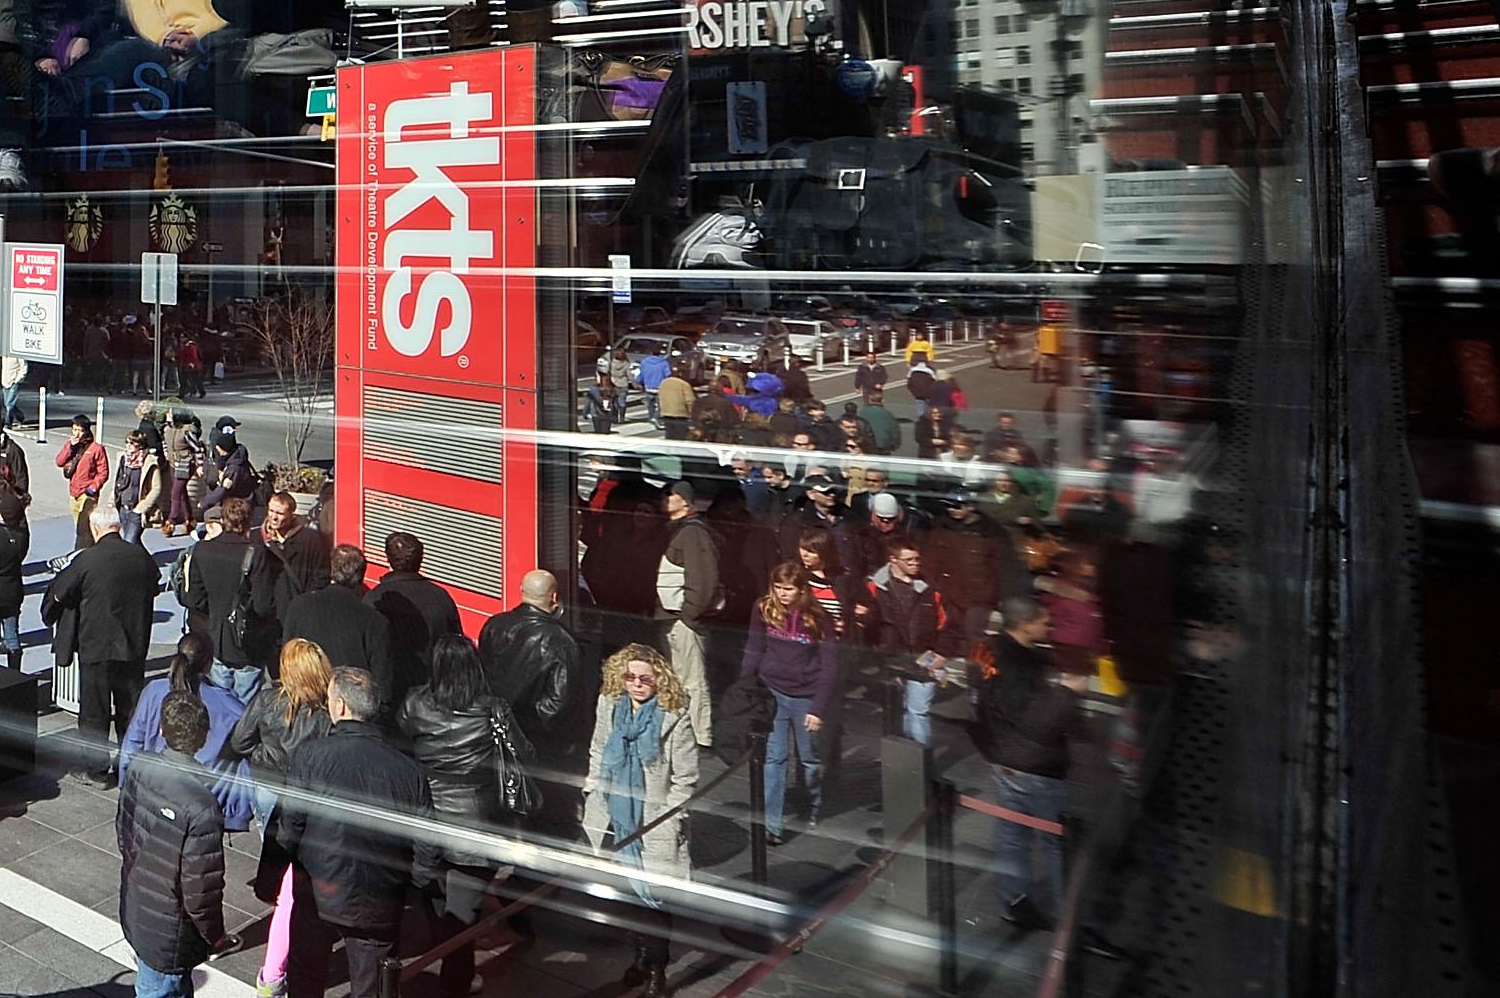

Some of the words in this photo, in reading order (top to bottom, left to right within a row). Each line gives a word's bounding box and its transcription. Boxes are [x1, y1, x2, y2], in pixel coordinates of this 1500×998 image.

[367, 114, 378, 161] service
[367, 164, 378, 176] of
[366, 179, 380, 229] Theatre
[382, 81, 501, 358] tkts
[18, 265, 34, 275] ANY
[35, 265, 53, 276] TIME
[366, 232, 379, 306] Development
[22, 324, 45, 336] WALK
[25, 338, 42, 350] BIKE
[367, 307, 379, 351] Fund
